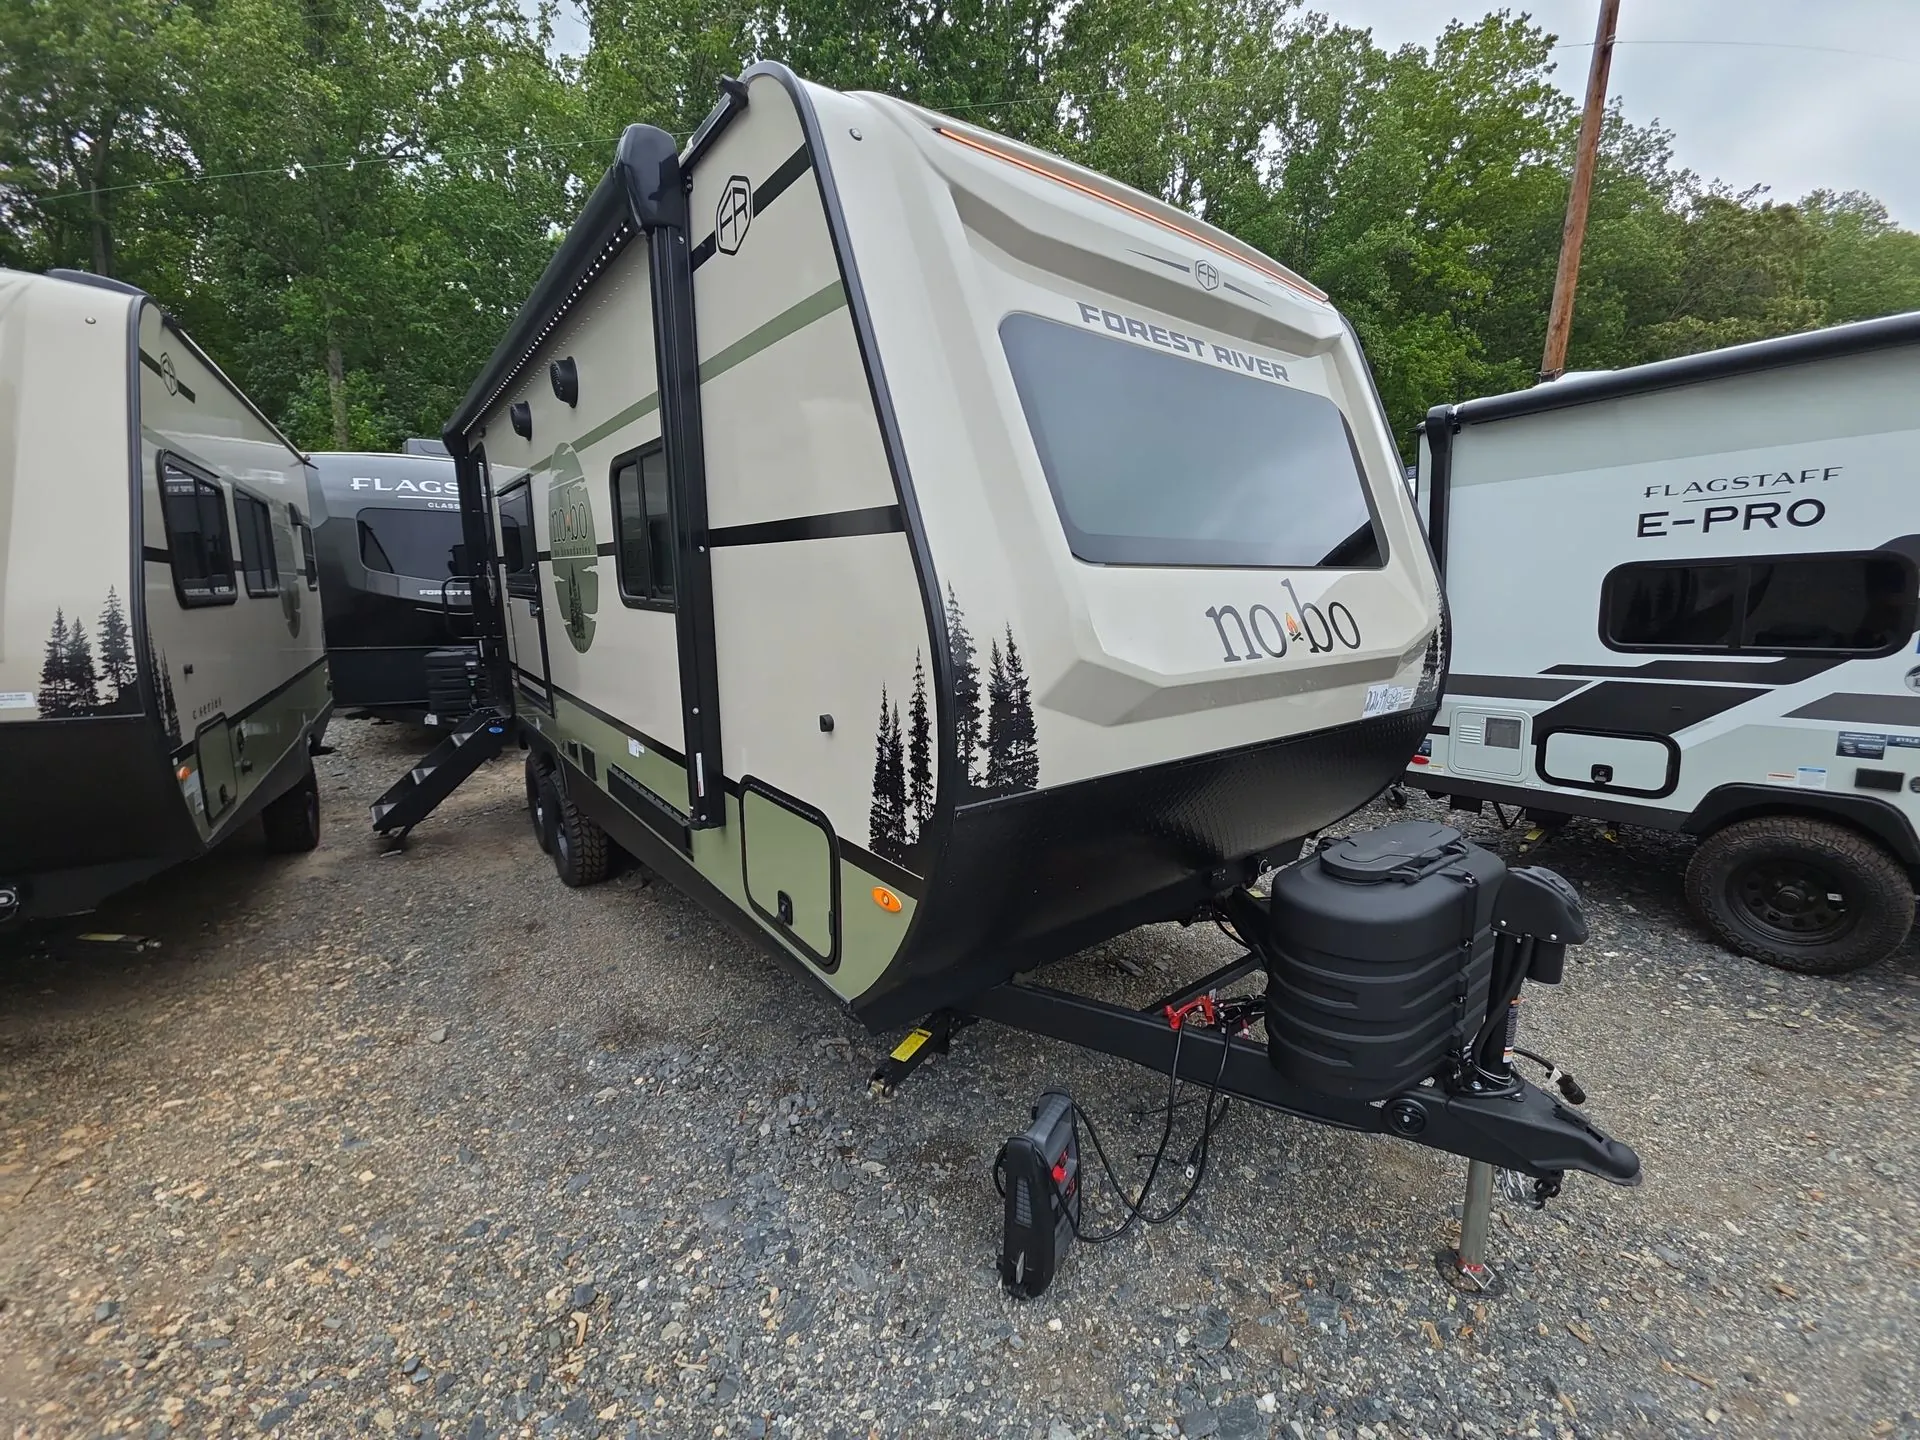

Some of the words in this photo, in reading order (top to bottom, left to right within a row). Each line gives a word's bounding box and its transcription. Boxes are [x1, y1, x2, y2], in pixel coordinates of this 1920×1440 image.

[1076, 301, 1205, 357] FOREST
[1211, 343, 1290, 382] RIVER
[1643, 466, 1843, 498] FLAGSTAFF
[1637, 498, 1826, 538] E-PRO
